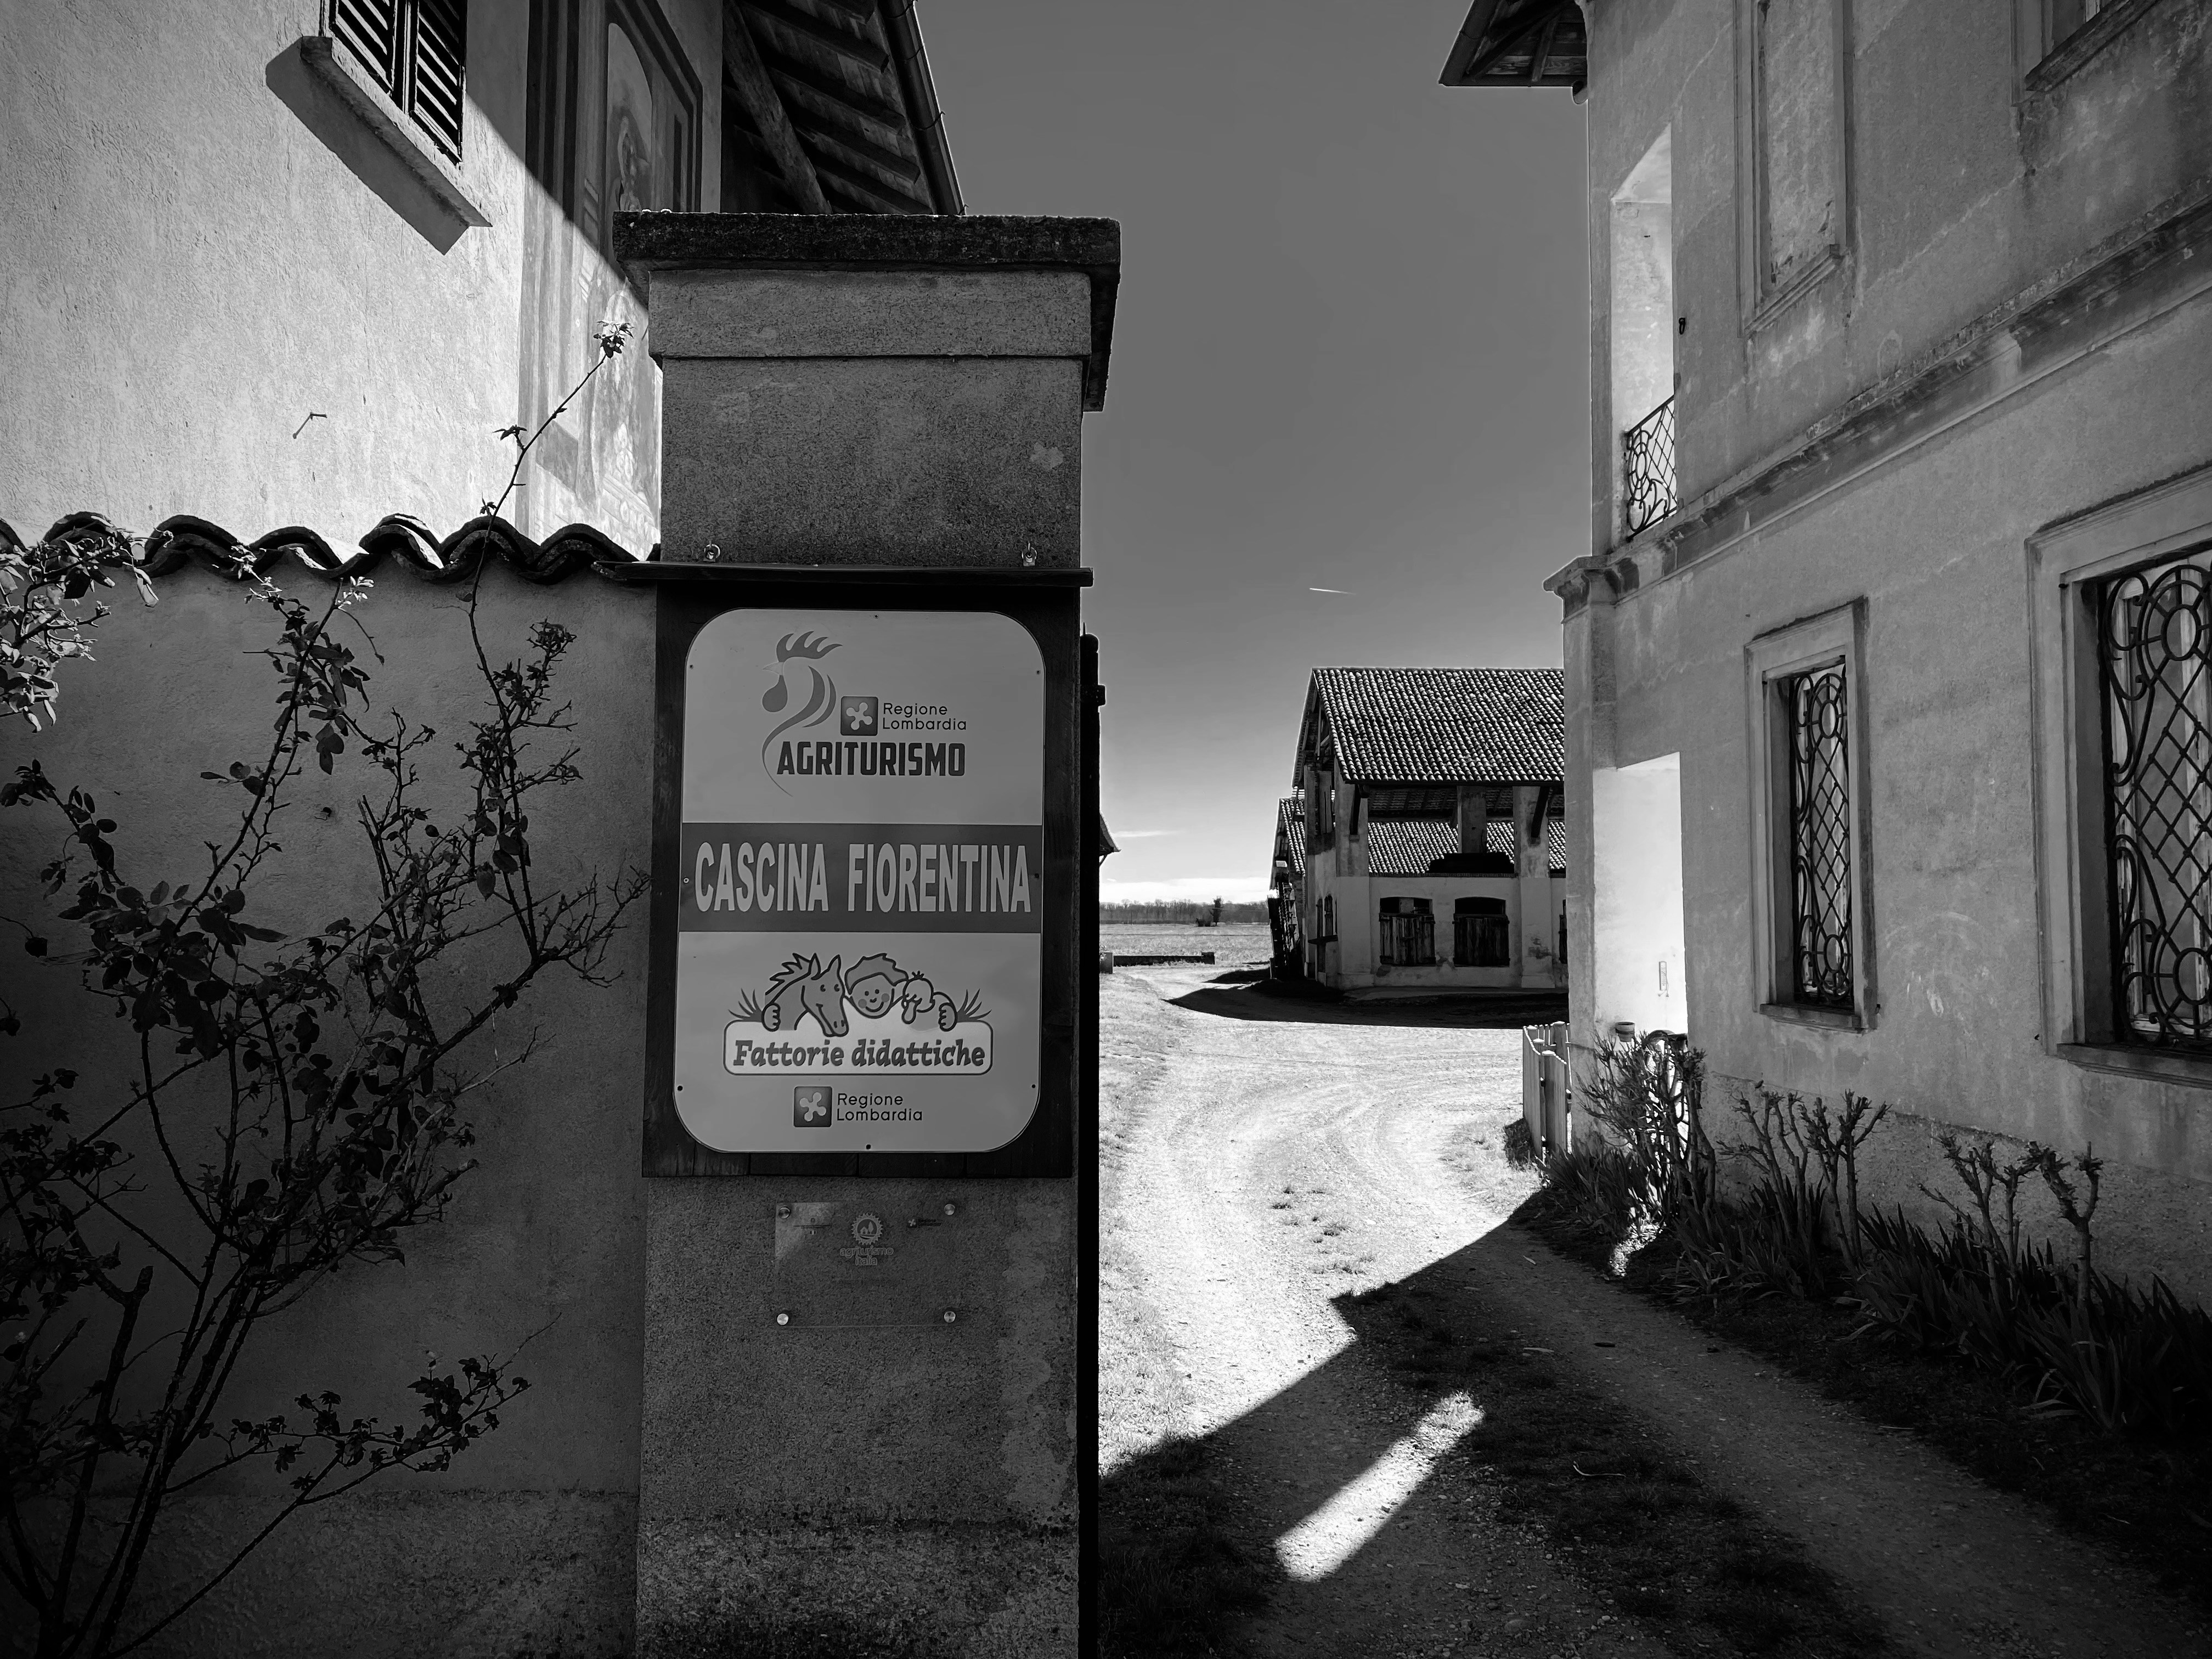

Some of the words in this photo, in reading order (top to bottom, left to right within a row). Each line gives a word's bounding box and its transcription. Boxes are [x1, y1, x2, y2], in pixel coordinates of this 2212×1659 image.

[883, 703, 947, 717] Regione
[883, 717, 967, 730] Lombardia
[777, 741, 966, 776] AGRITURISMO
[695, 842, 829, 913] CASCINA
[848, 843, 1031, 913] FIORENTINA
[733, 1039, 844, 1067] Fattorie
[851, 1039, 985, 1067] didattiche
[837, 1093, 903, 1107] Regione
[837, 1108, 922, 1122] Lombardia
[840, 1245, 894, 1259] agriturismo
[855, 1255, 878, 1266] italia
